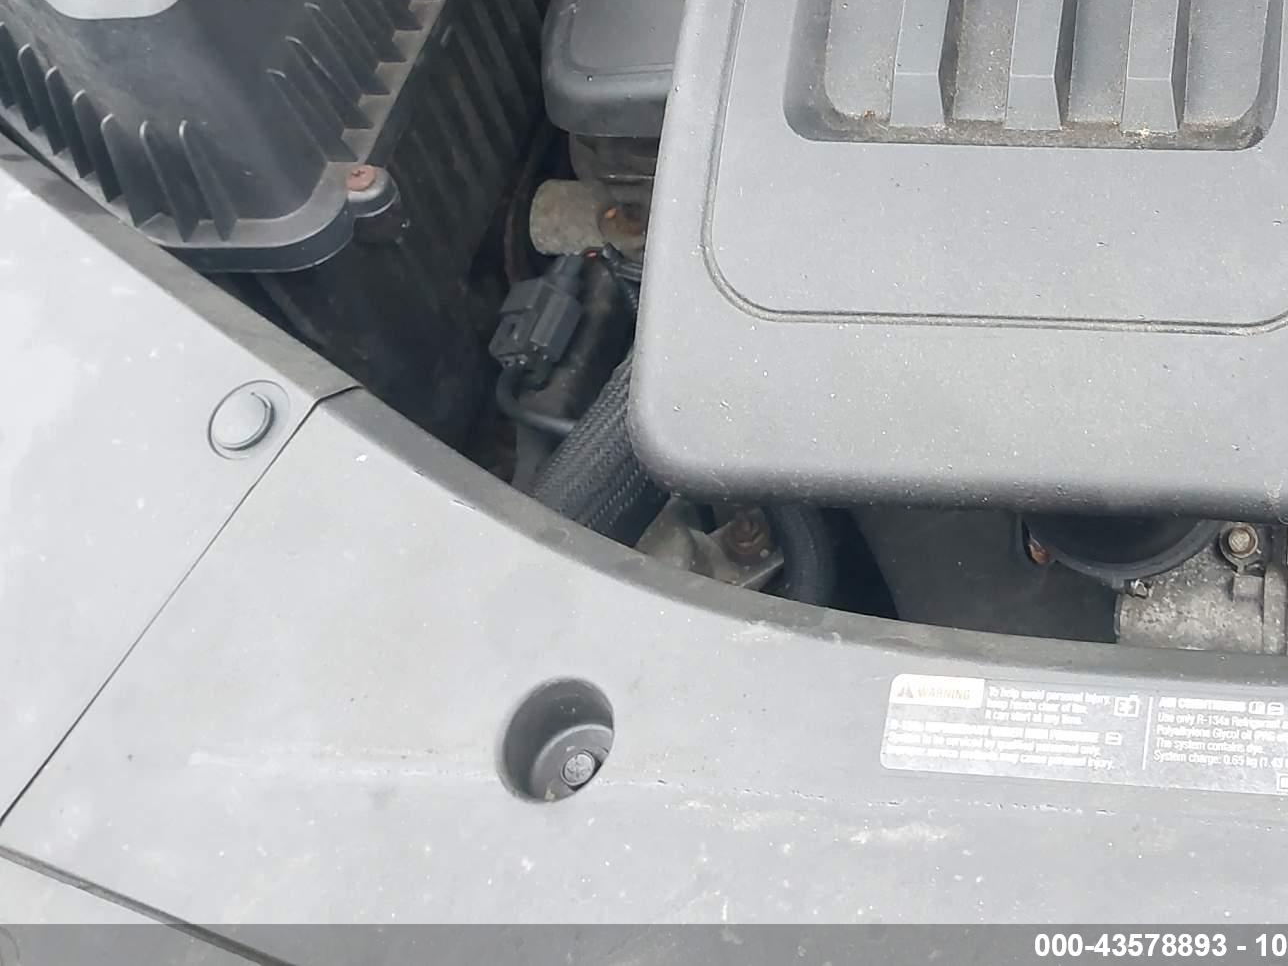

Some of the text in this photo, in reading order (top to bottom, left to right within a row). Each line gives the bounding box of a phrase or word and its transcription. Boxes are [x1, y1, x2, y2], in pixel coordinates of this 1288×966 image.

[917, 686, 971, 700] WARNING
[1157, 712, 1174, 723] Use
[1176, 713, 1195, 726] only
[1212, 727, 1240, 740] Glycol
[1156, 737, 1173, 748] The
[1174, 740, 1206, 752] system
[1207, 741, 1246, 753] contains
[1153, 749, 1187, 763] System
